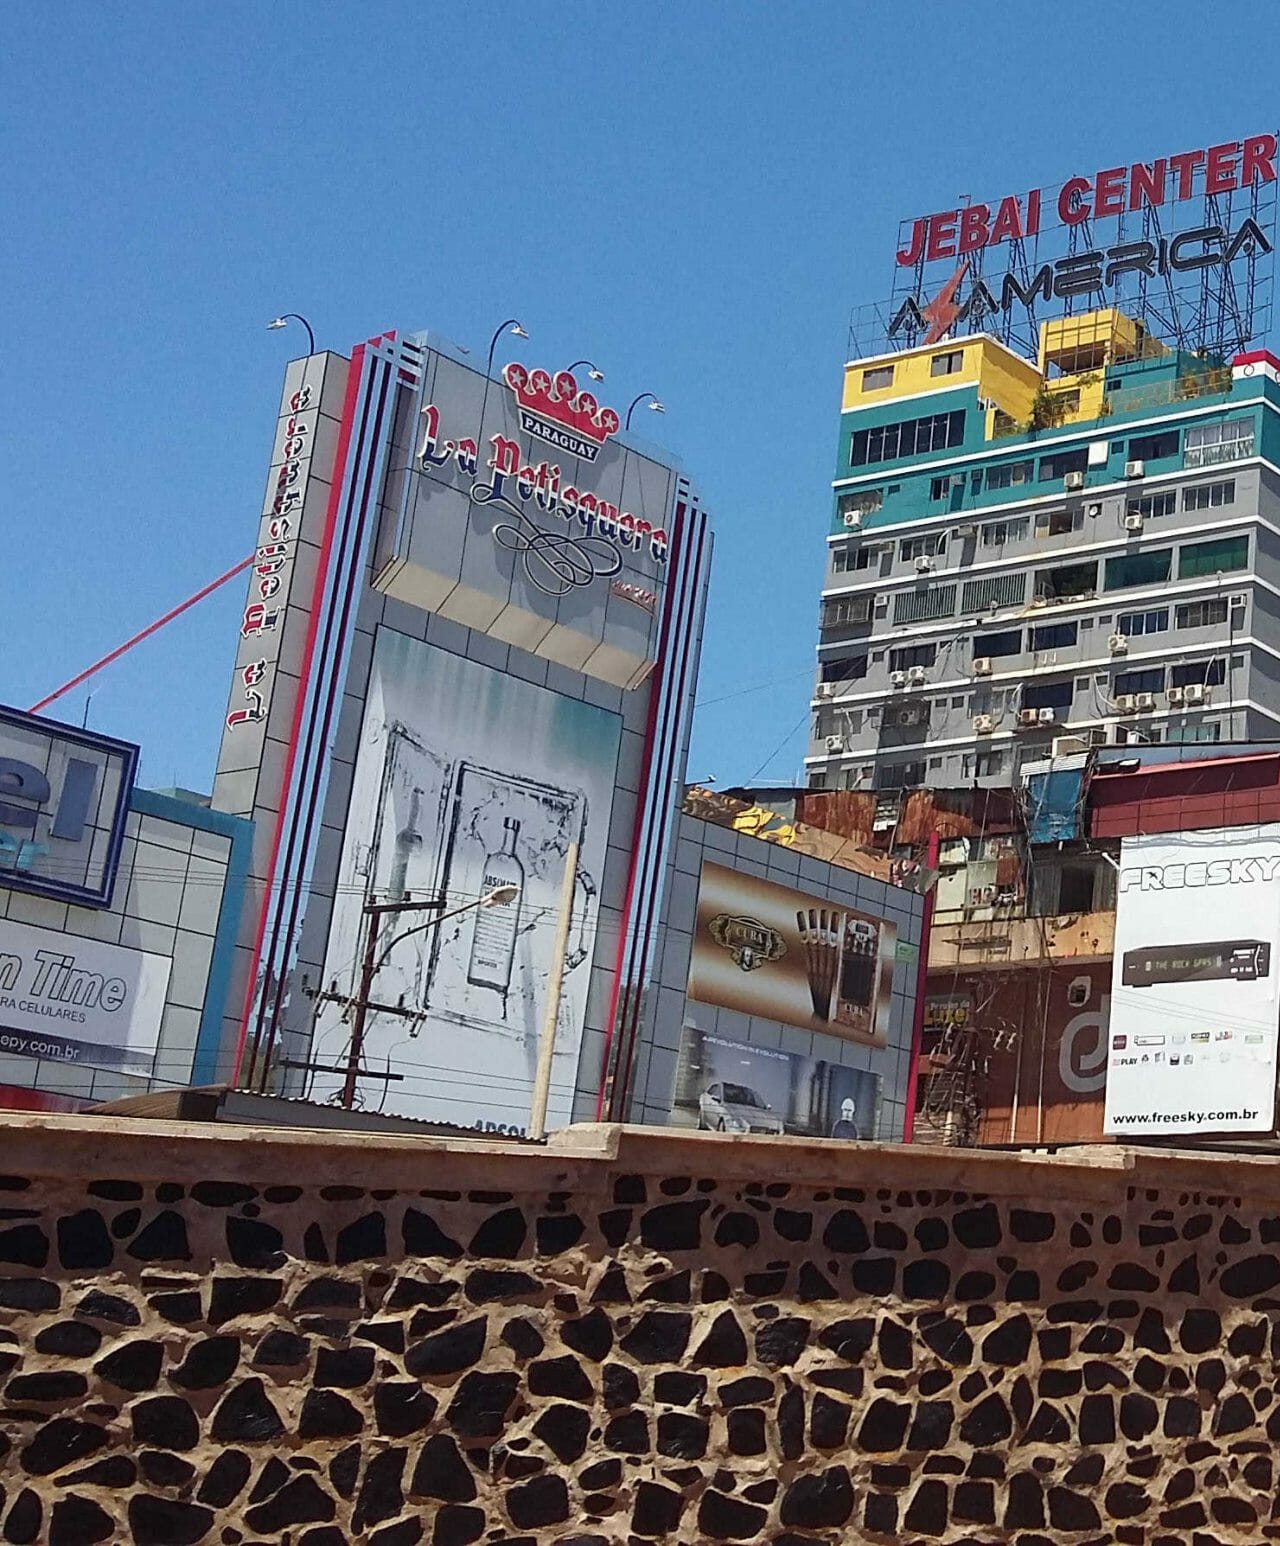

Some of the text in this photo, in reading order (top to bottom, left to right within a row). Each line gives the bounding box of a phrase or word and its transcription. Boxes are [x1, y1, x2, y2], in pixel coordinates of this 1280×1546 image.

[895, 132, 1278, 267] JEBAI CENTER
[958, 216, 1273, 323] AMERICA
[524, 416, 595, 459] PARAGUAY
[417, 404, 669, 565] La Petisquera
[226, 658, 267, 732] La
[18, 999, 87, 1024] CELULARES
[29, 949, 127, 1013] Time
[1113, 1108, 1259, 1124] www.freesky.com.br
